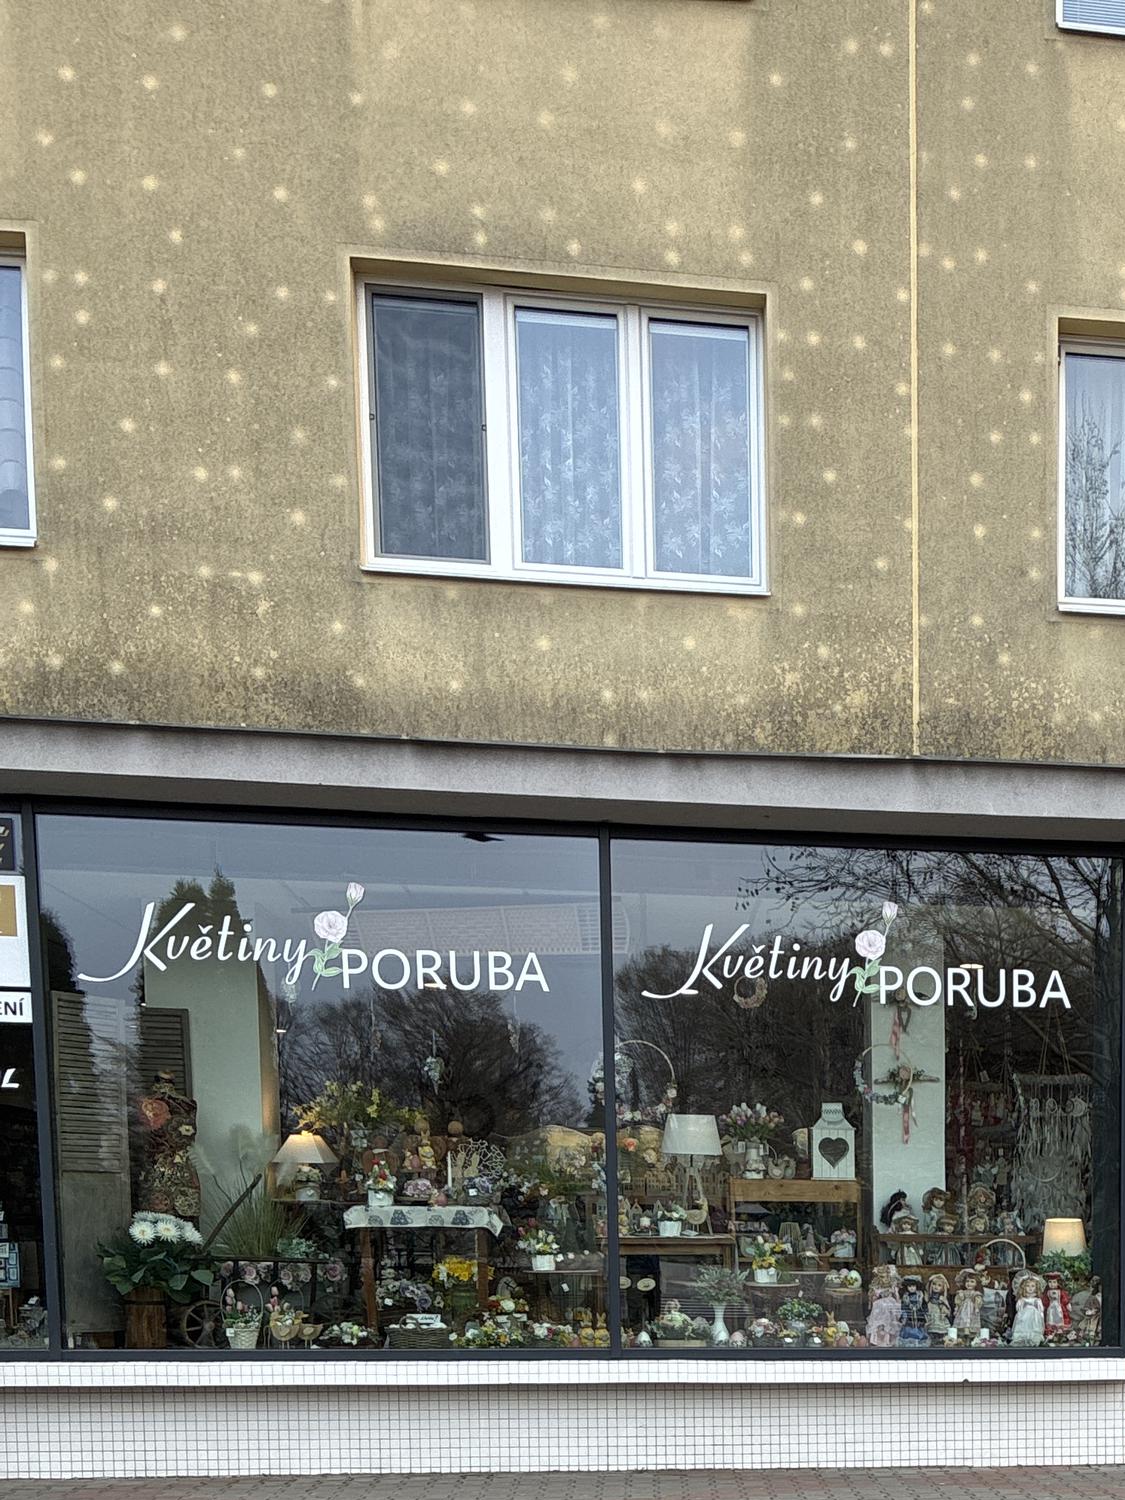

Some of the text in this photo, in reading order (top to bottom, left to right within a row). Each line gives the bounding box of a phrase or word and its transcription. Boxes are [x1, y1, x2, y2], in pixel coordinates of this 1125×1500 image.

[77, 901, 550, 993] Květiny PORUBA
[641, 923, 1072, 1009] Květiny PORUBA
